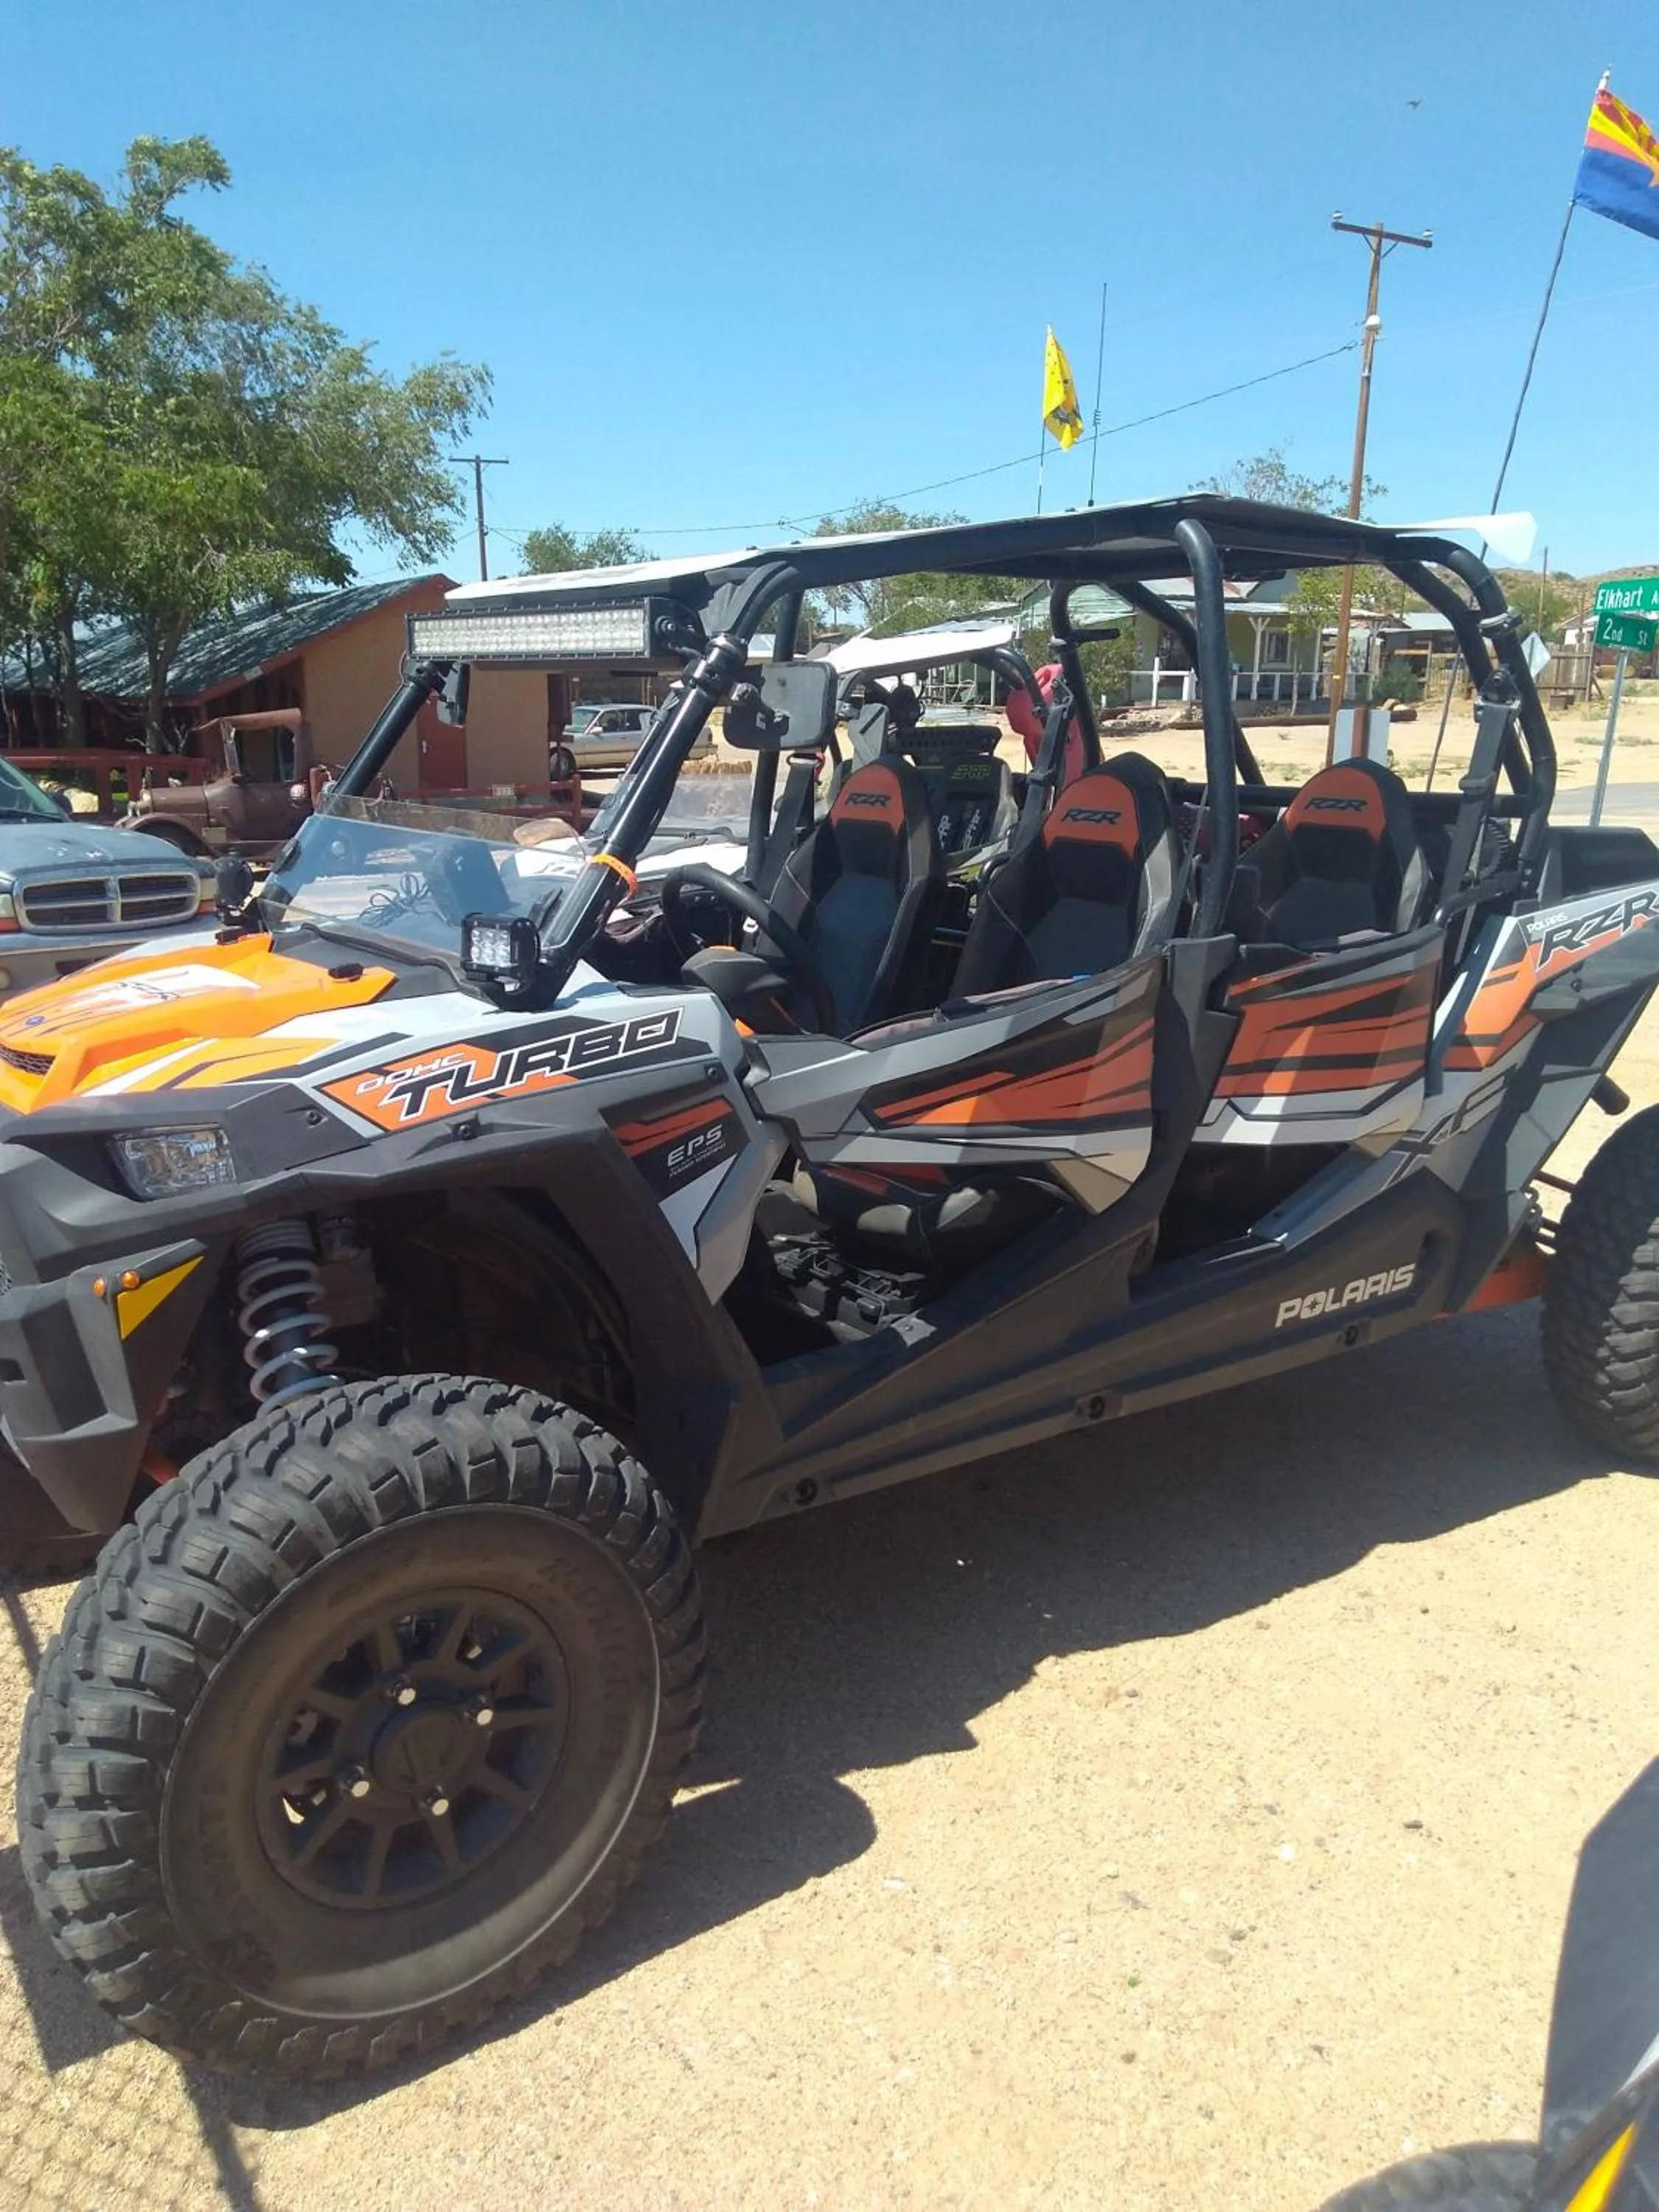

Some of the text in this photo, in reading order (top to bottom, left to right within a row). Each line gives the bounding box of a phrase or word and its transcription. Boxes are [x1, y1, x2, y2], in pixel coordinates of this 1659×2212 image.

[1596, 585, 1644, 610] Elkhart
[1602, 618, 1623, 642] 2nd
[845, 793, 892, 807] RZR
[1304, 797, 1368, 813] RZR
[1061, 808, 1121, 824] RZR
[1526, 911, 1568, 933] POLARIS
[1535, 889, 1659, 973] RZR
[355, 1052, 466, 1096] DOHC
[377, 1006, 684, 1121] TURBO
[667, 1124, 723, 1167] EPS
[1274, 1263, 1416, 1328] POLARIS
